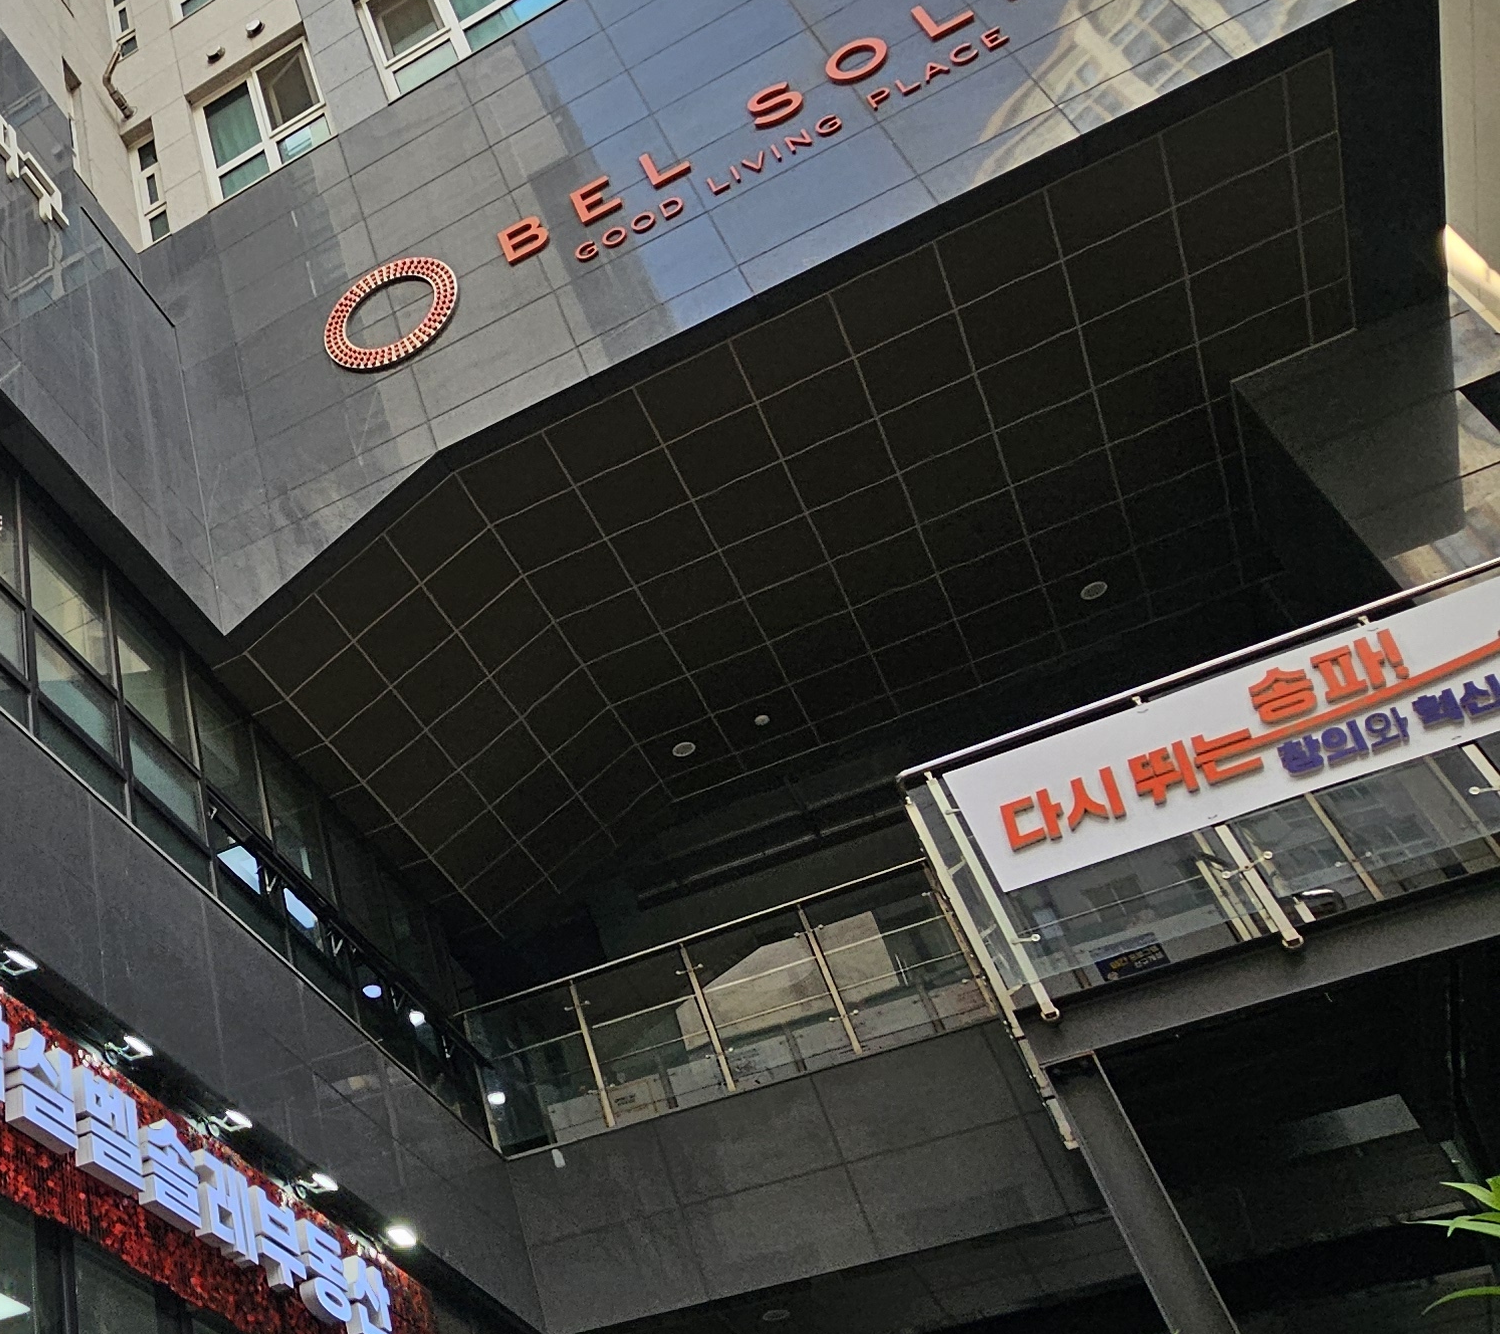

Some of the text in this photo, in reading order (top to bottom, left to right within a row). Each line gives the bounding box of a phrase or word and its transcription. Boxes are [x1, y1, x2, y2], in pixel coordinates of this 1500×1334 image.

[496, 152, 692, 266] BEL
[573, 26, 1011, 263] GOOD LIVING PLACE
[999, 628, 1411, 854] 다시 뛰는 송파!
[1277, 673, 1500, 778] 창의와 혁신
